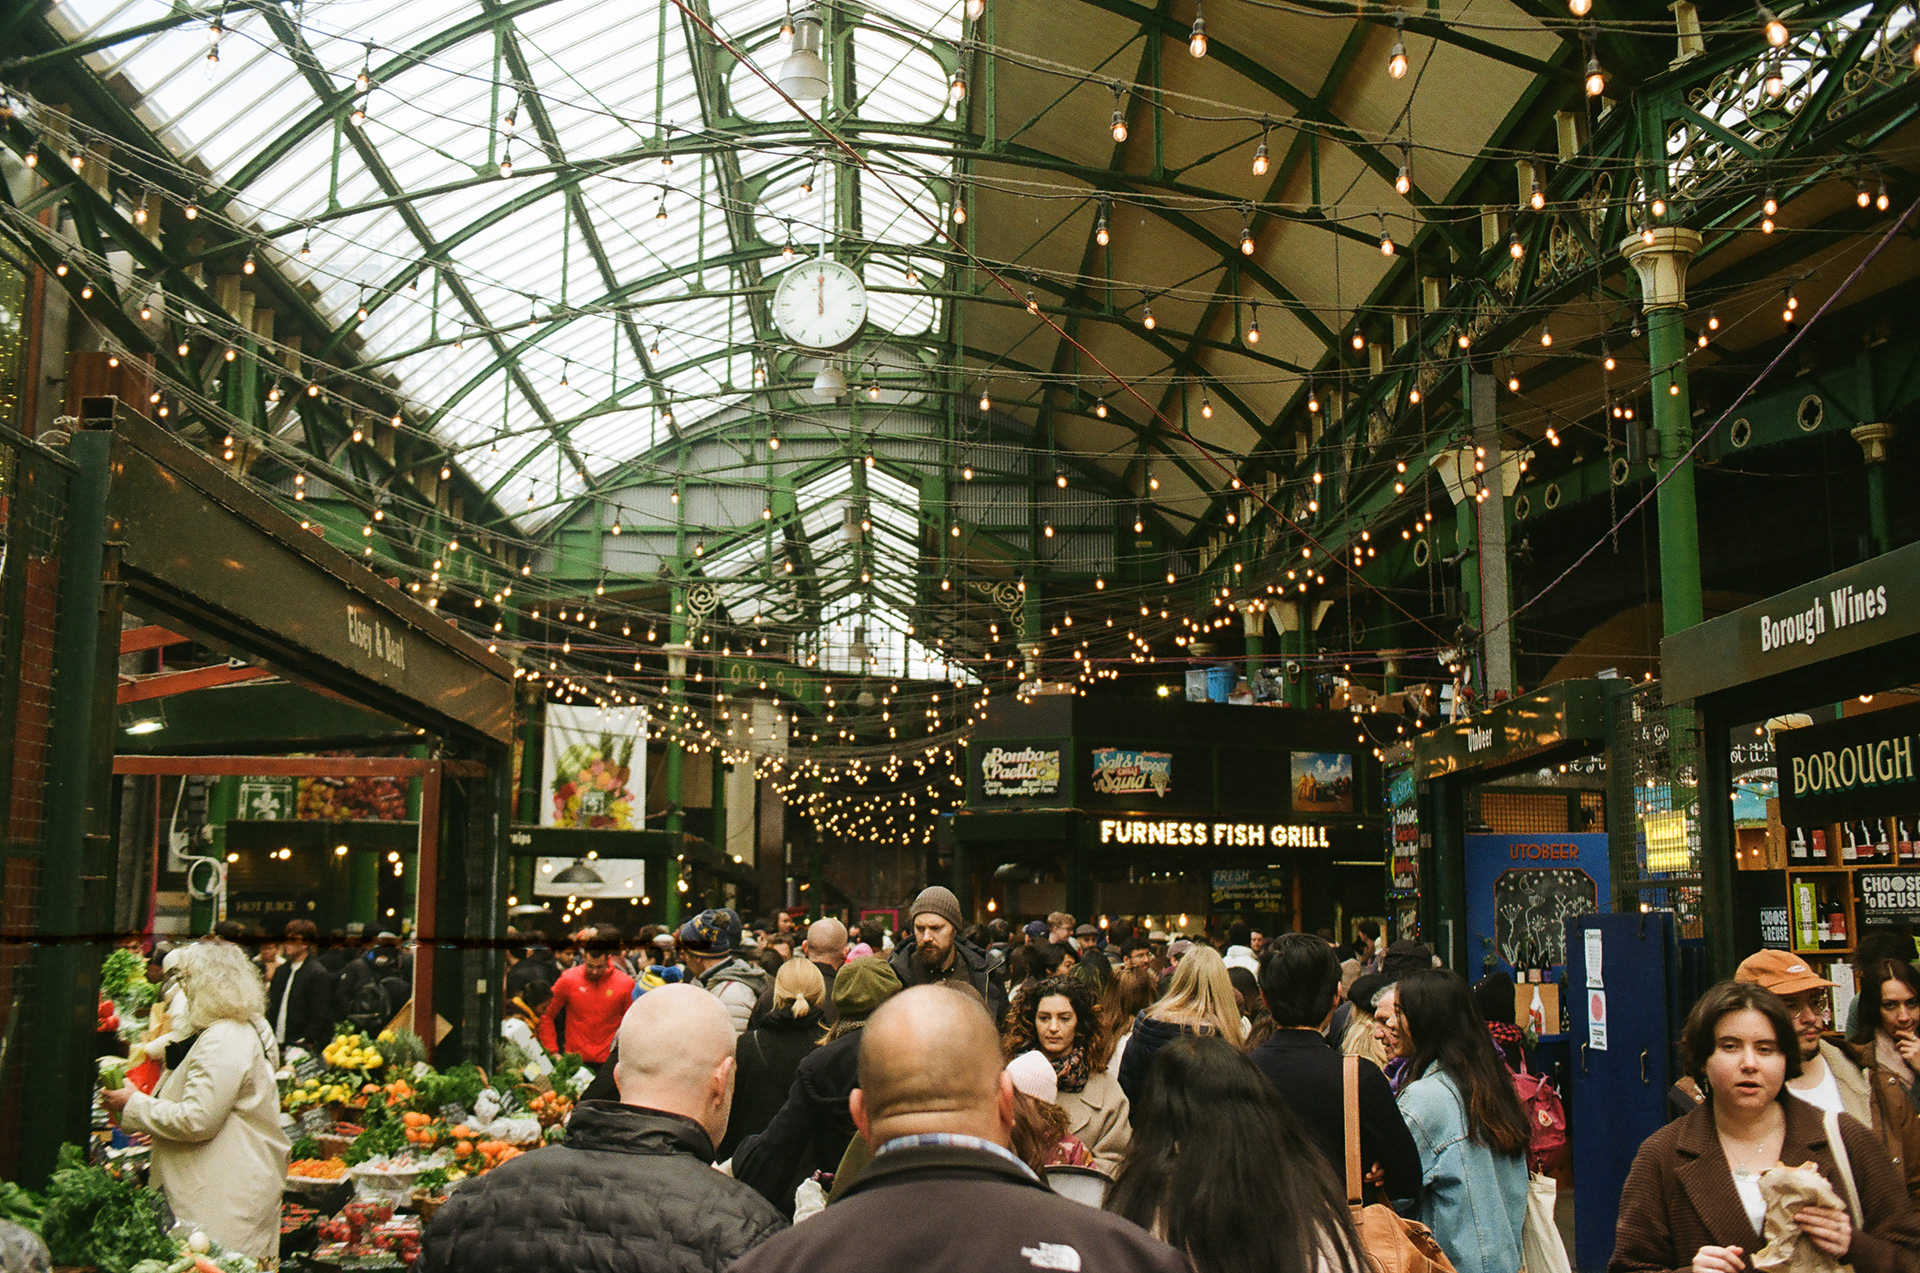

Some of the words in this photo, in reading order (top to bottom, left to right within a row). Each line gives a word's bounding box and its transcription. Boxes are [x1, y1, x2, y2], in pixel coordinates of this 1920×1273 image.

[1760, 596, 1825, 652] Borough
[1830, 585, 1887, 629] Wines
[1467, 726, 1492, 753] Utobeer
[991, 747, 1045, 764] Bomba
[1099, 753, 1123, 769] Salt
[1123, 756, 1133, 768] &
[1135, 755, 1168, 773] Pepper
[1792, 735, 1913, 796] BOROUGH
[990, 762, 1037, 779] Paella
[1098, 768, 1147, 794] Squid
[1101, 820, 1208, 845] FURNESS
[1213, 823, 1266, 846] FISH
[1271, 825, 1330, 848] GRILL
[1509, 844, 1580, 860] UTOBEER
[1213, 870, 1250, 883] FRESH
[1760, 910, 1788, 926] CHOOSE
